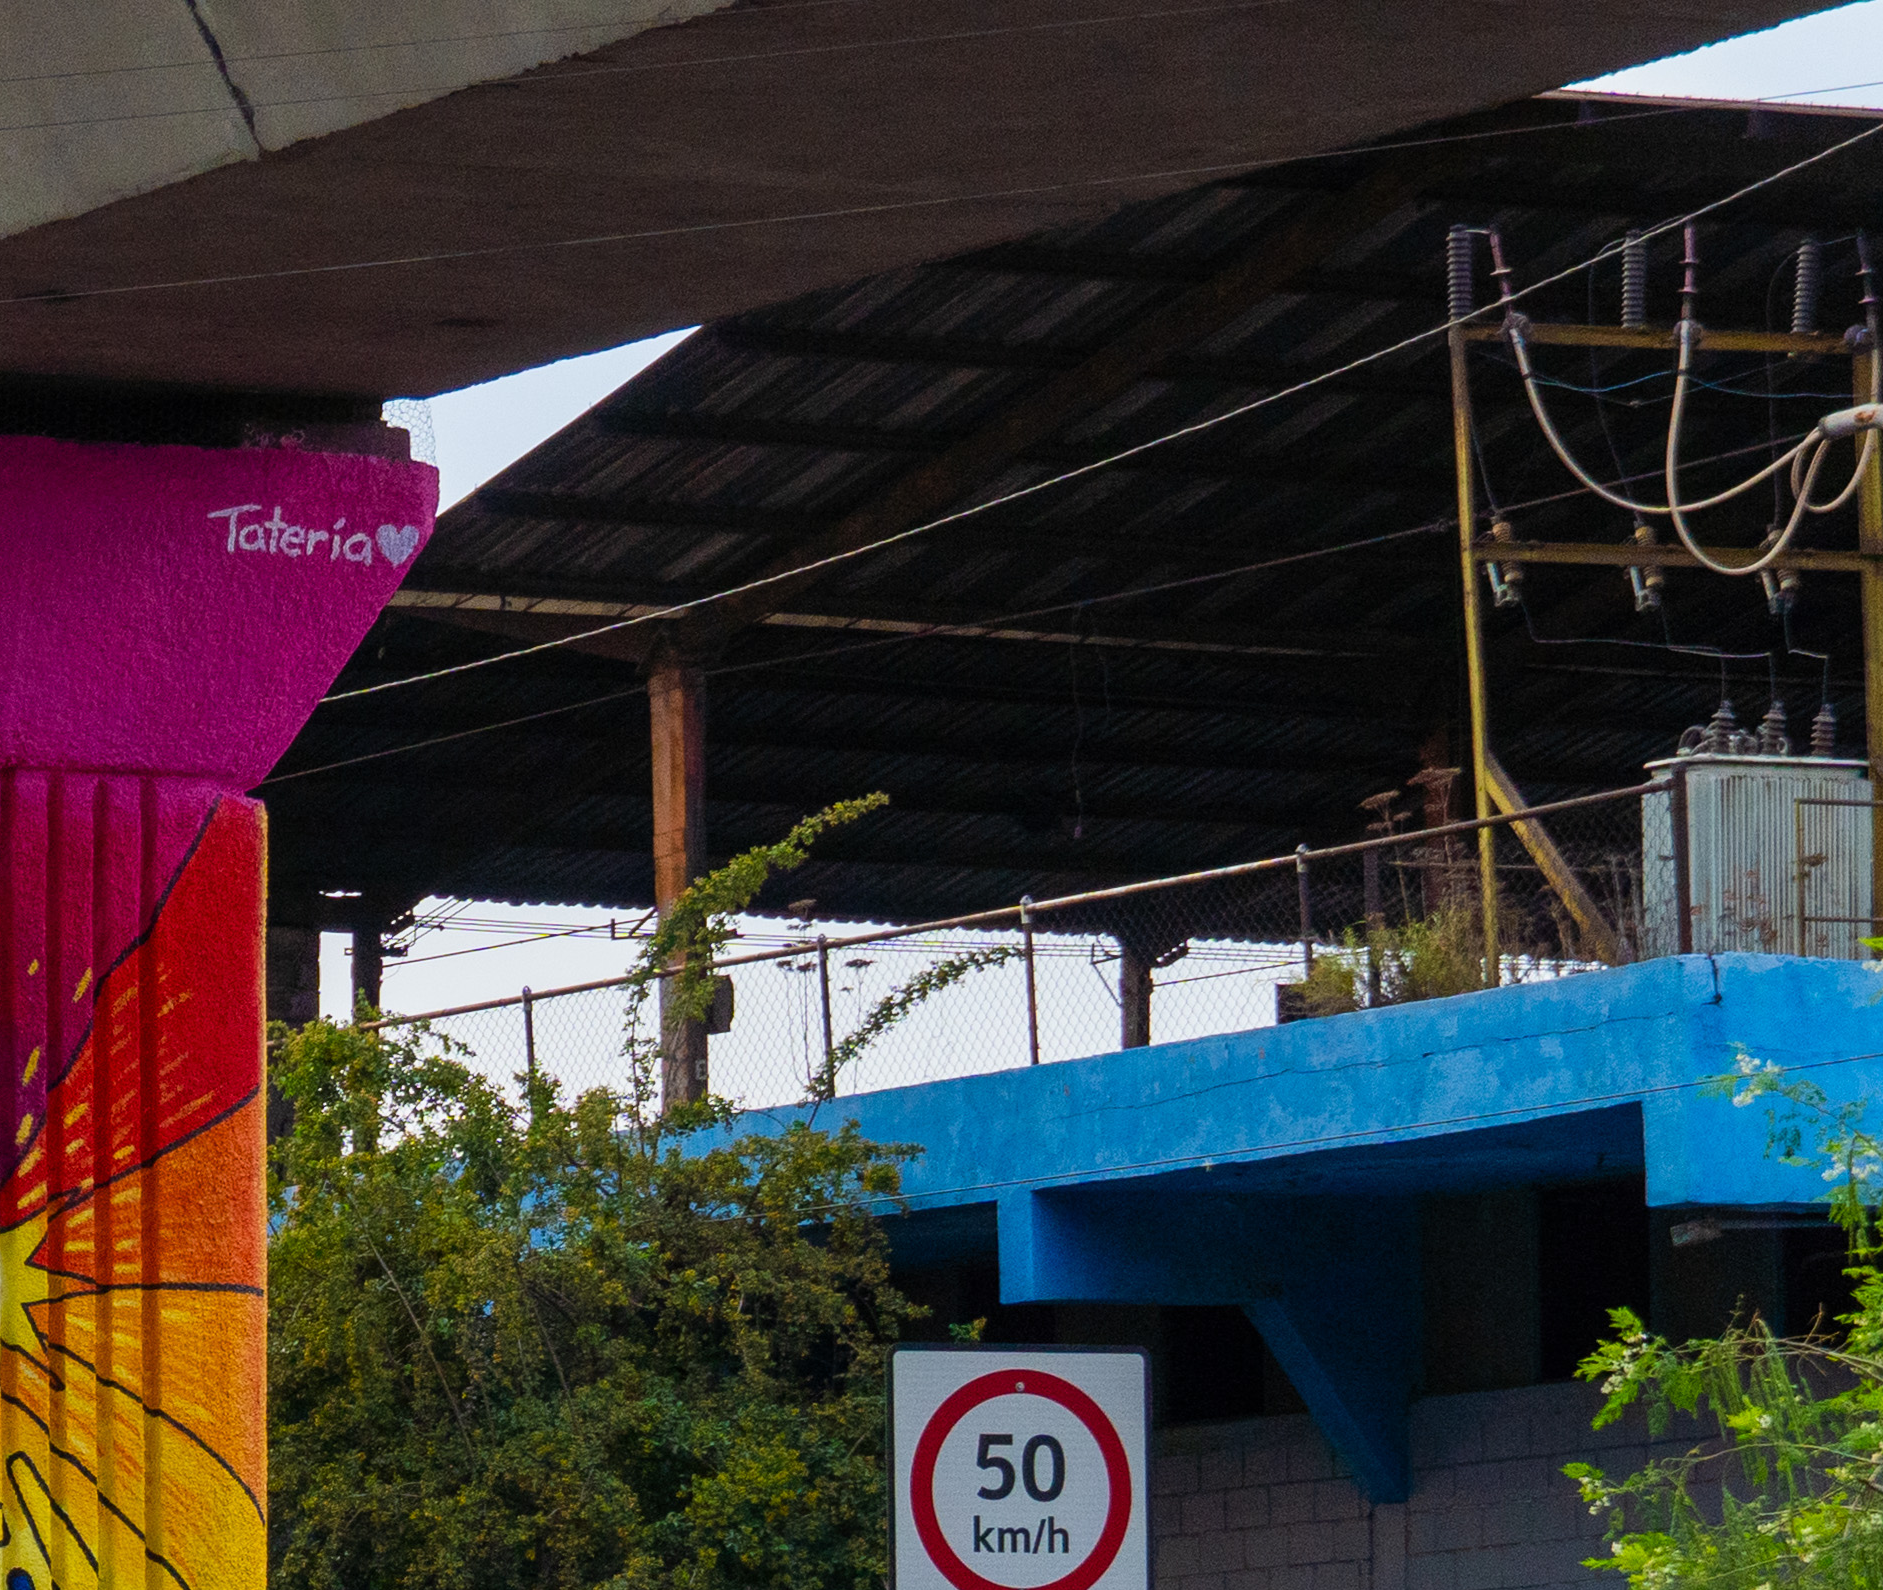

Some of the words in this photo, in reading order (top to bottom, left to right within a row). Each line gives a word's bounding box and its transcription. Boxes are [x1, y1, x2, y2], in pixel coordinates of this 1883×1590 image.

[207, 504, 372, 566] Tatería
[976, 1433, 1066, 1502] 50
[973, 1515, 1069, 1554] km/h
